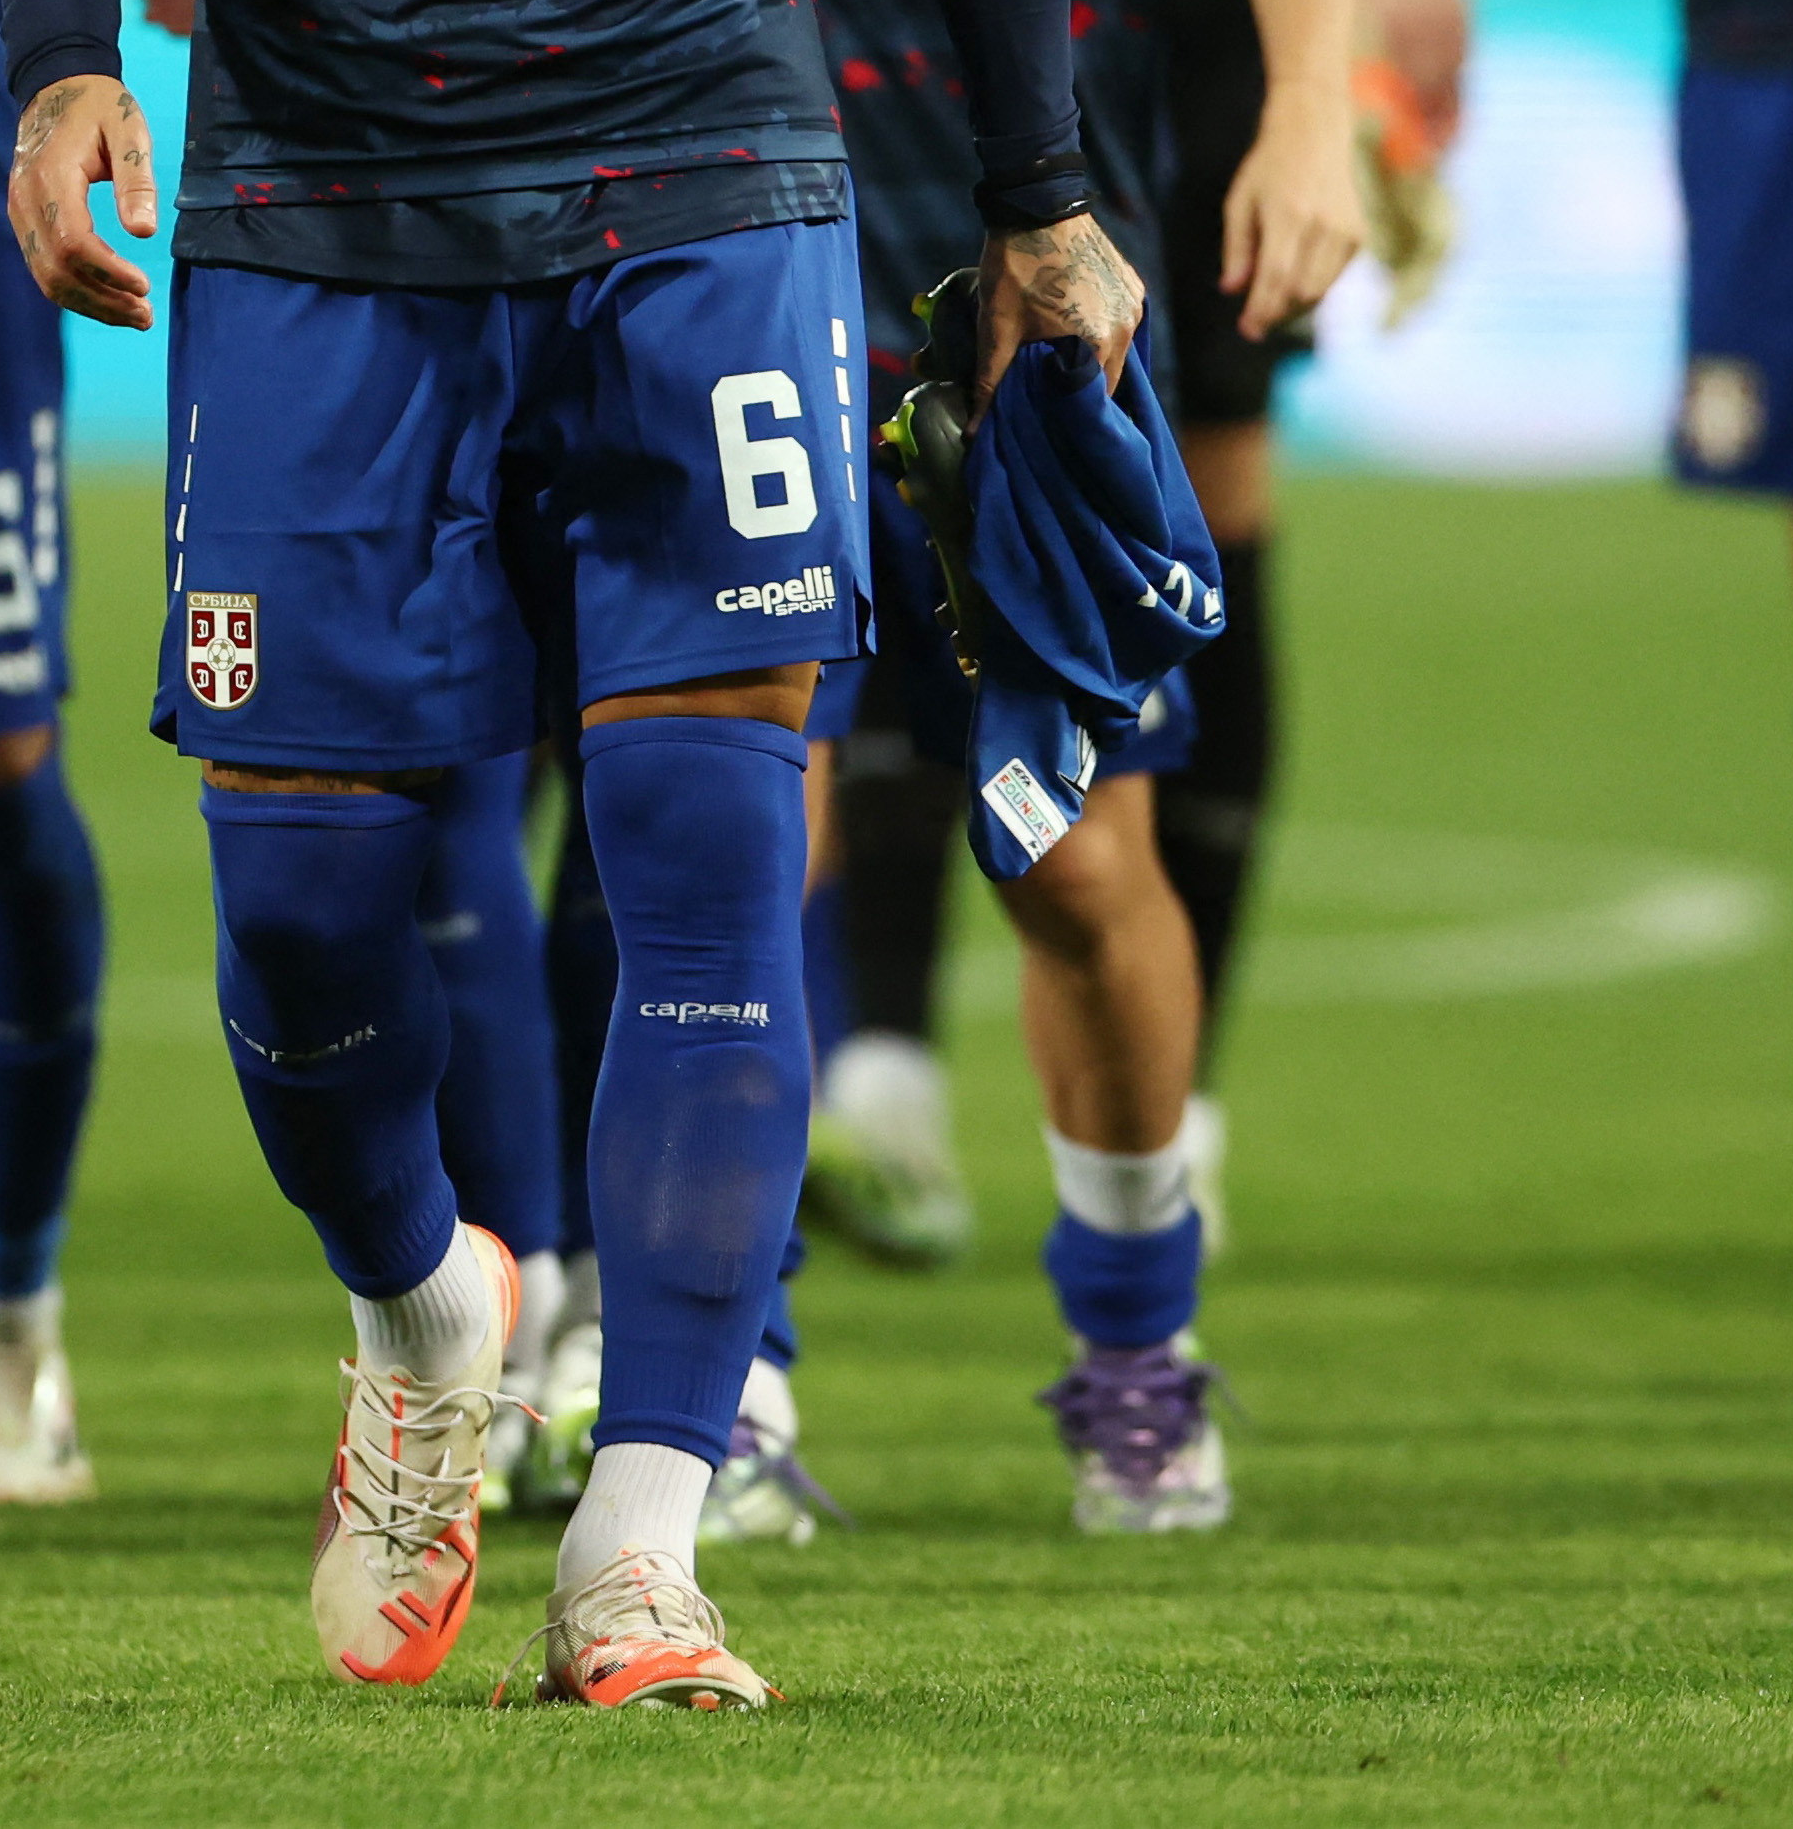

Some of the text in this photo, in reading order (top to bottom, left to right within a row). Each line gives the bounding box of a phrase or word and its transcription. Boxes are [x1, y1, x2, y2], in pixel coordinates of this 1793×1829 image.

[711, 370, 818, 539] 6
[189, 594, 253, 608] СРБИЈА
[715, 565, 835, 615] capelli
[774, 597, 836, 617] SPORT
[1011, 764, 1032, 786] UEFA
